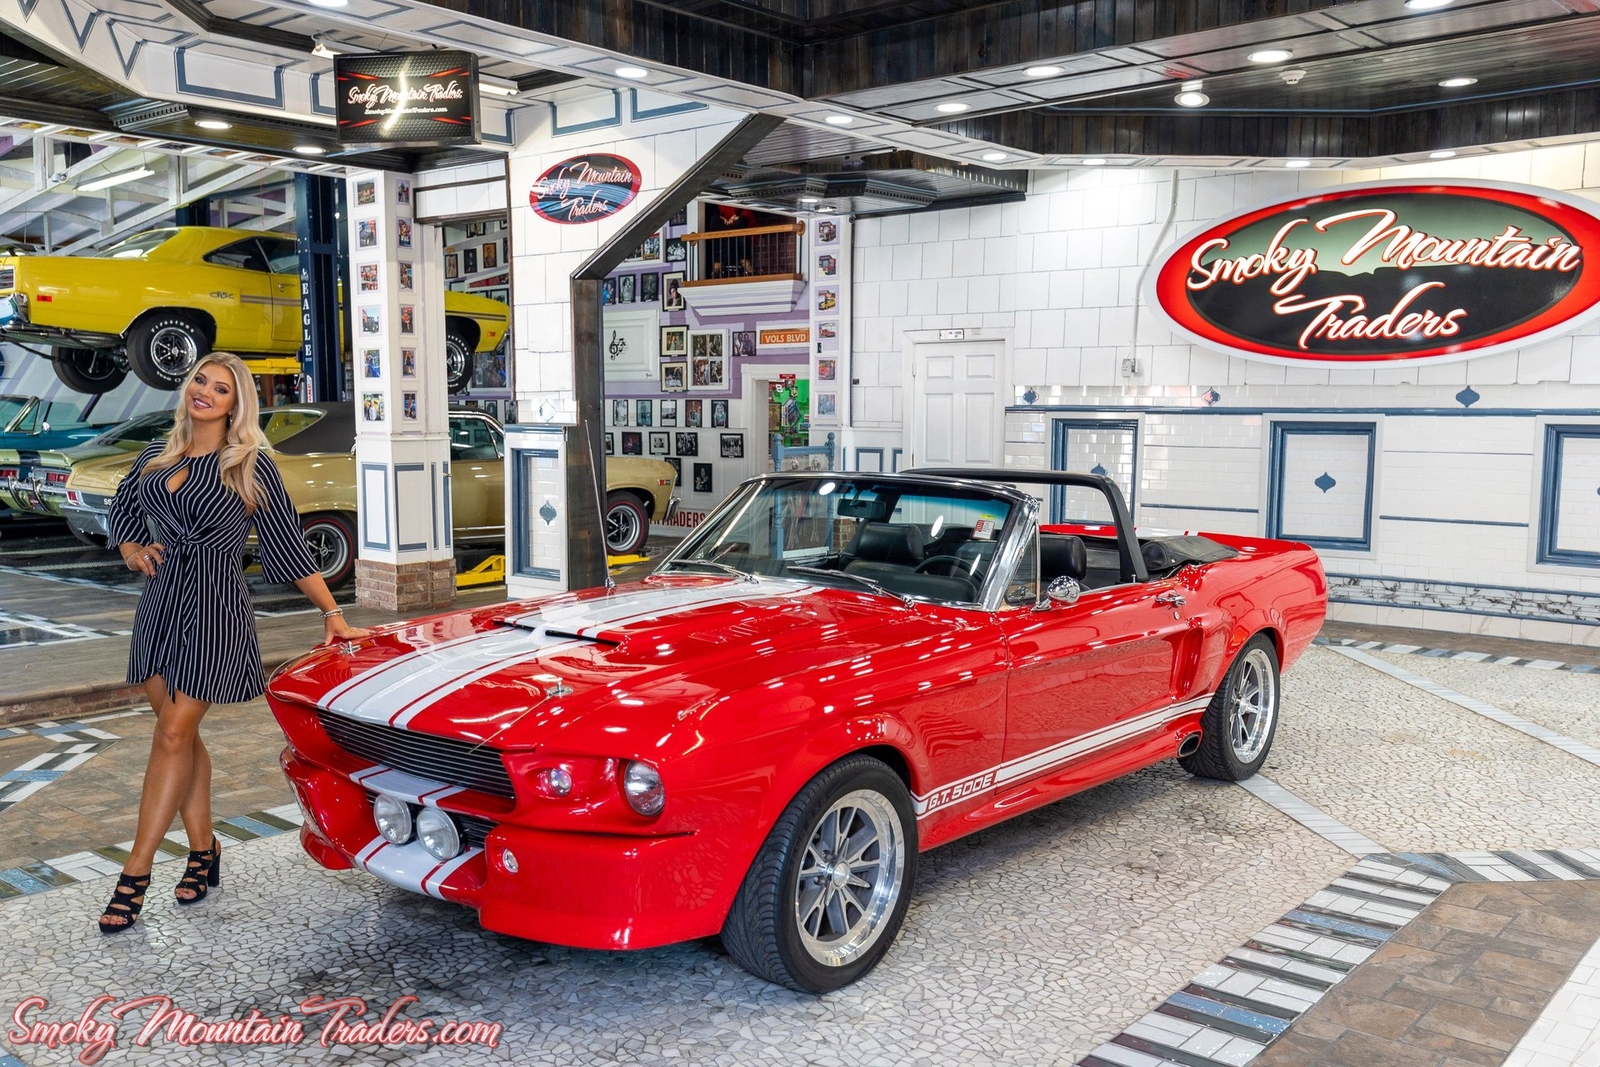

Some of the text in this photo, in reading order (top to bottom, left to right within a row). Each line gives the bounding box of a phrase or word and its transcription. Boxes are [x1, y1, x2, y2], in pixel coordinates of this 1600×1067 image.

[348, 80, 463, 108] Smoky Motain Traders
[364, 106, 448, 115] SmokyMoainTraders.com
[537, 161, 633, 199] Smoky Mountain
[561, 190, 608, 221] Traders
[1187, 208, 1583, 296] Smoky Mountain
[302, 282, 312, 356] EAGLE
[1274, 281, 1469, 349] Traders
[765, 333, 806, 343] VOLS BLVD
[928, 773, 993, 810] G.T. 500E
